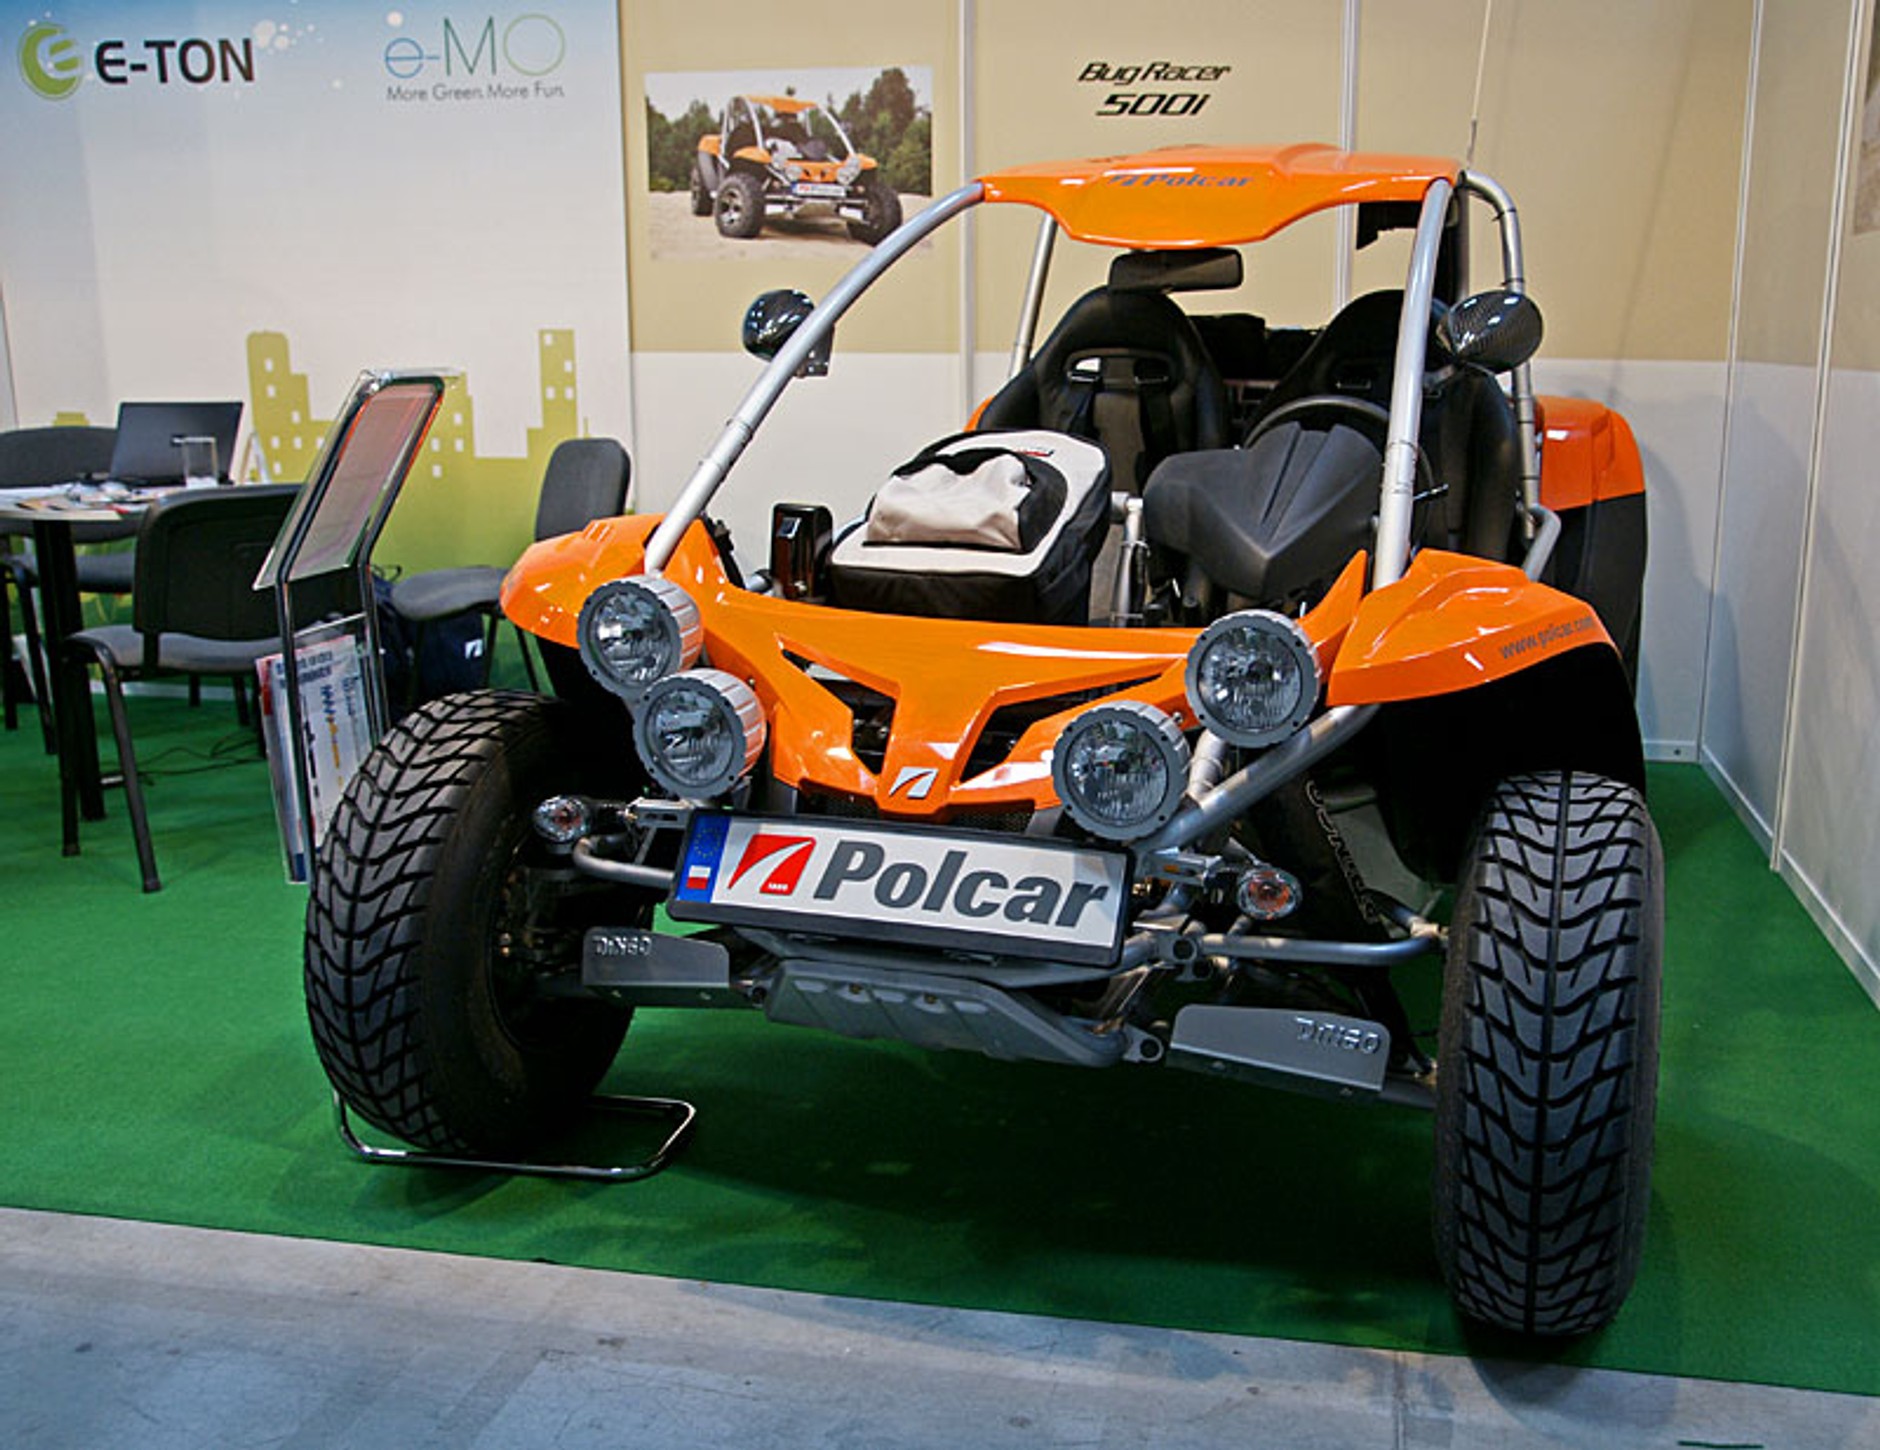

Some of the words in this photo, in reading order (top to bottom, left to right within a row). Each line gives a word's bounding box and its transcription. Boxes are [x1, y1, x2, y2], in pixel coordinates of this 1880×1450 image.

[95, 38, 254, 83] E-TON
[1078, 62, 1142, 86] Bug
[1140, 62, 1232, 81] Racer
[387, 86, 428, 100] More
[487, 83, 529, 98] More
[1143, 174, 1253, 187] Polcar
[813, 840, 1108, 928] Polcar
